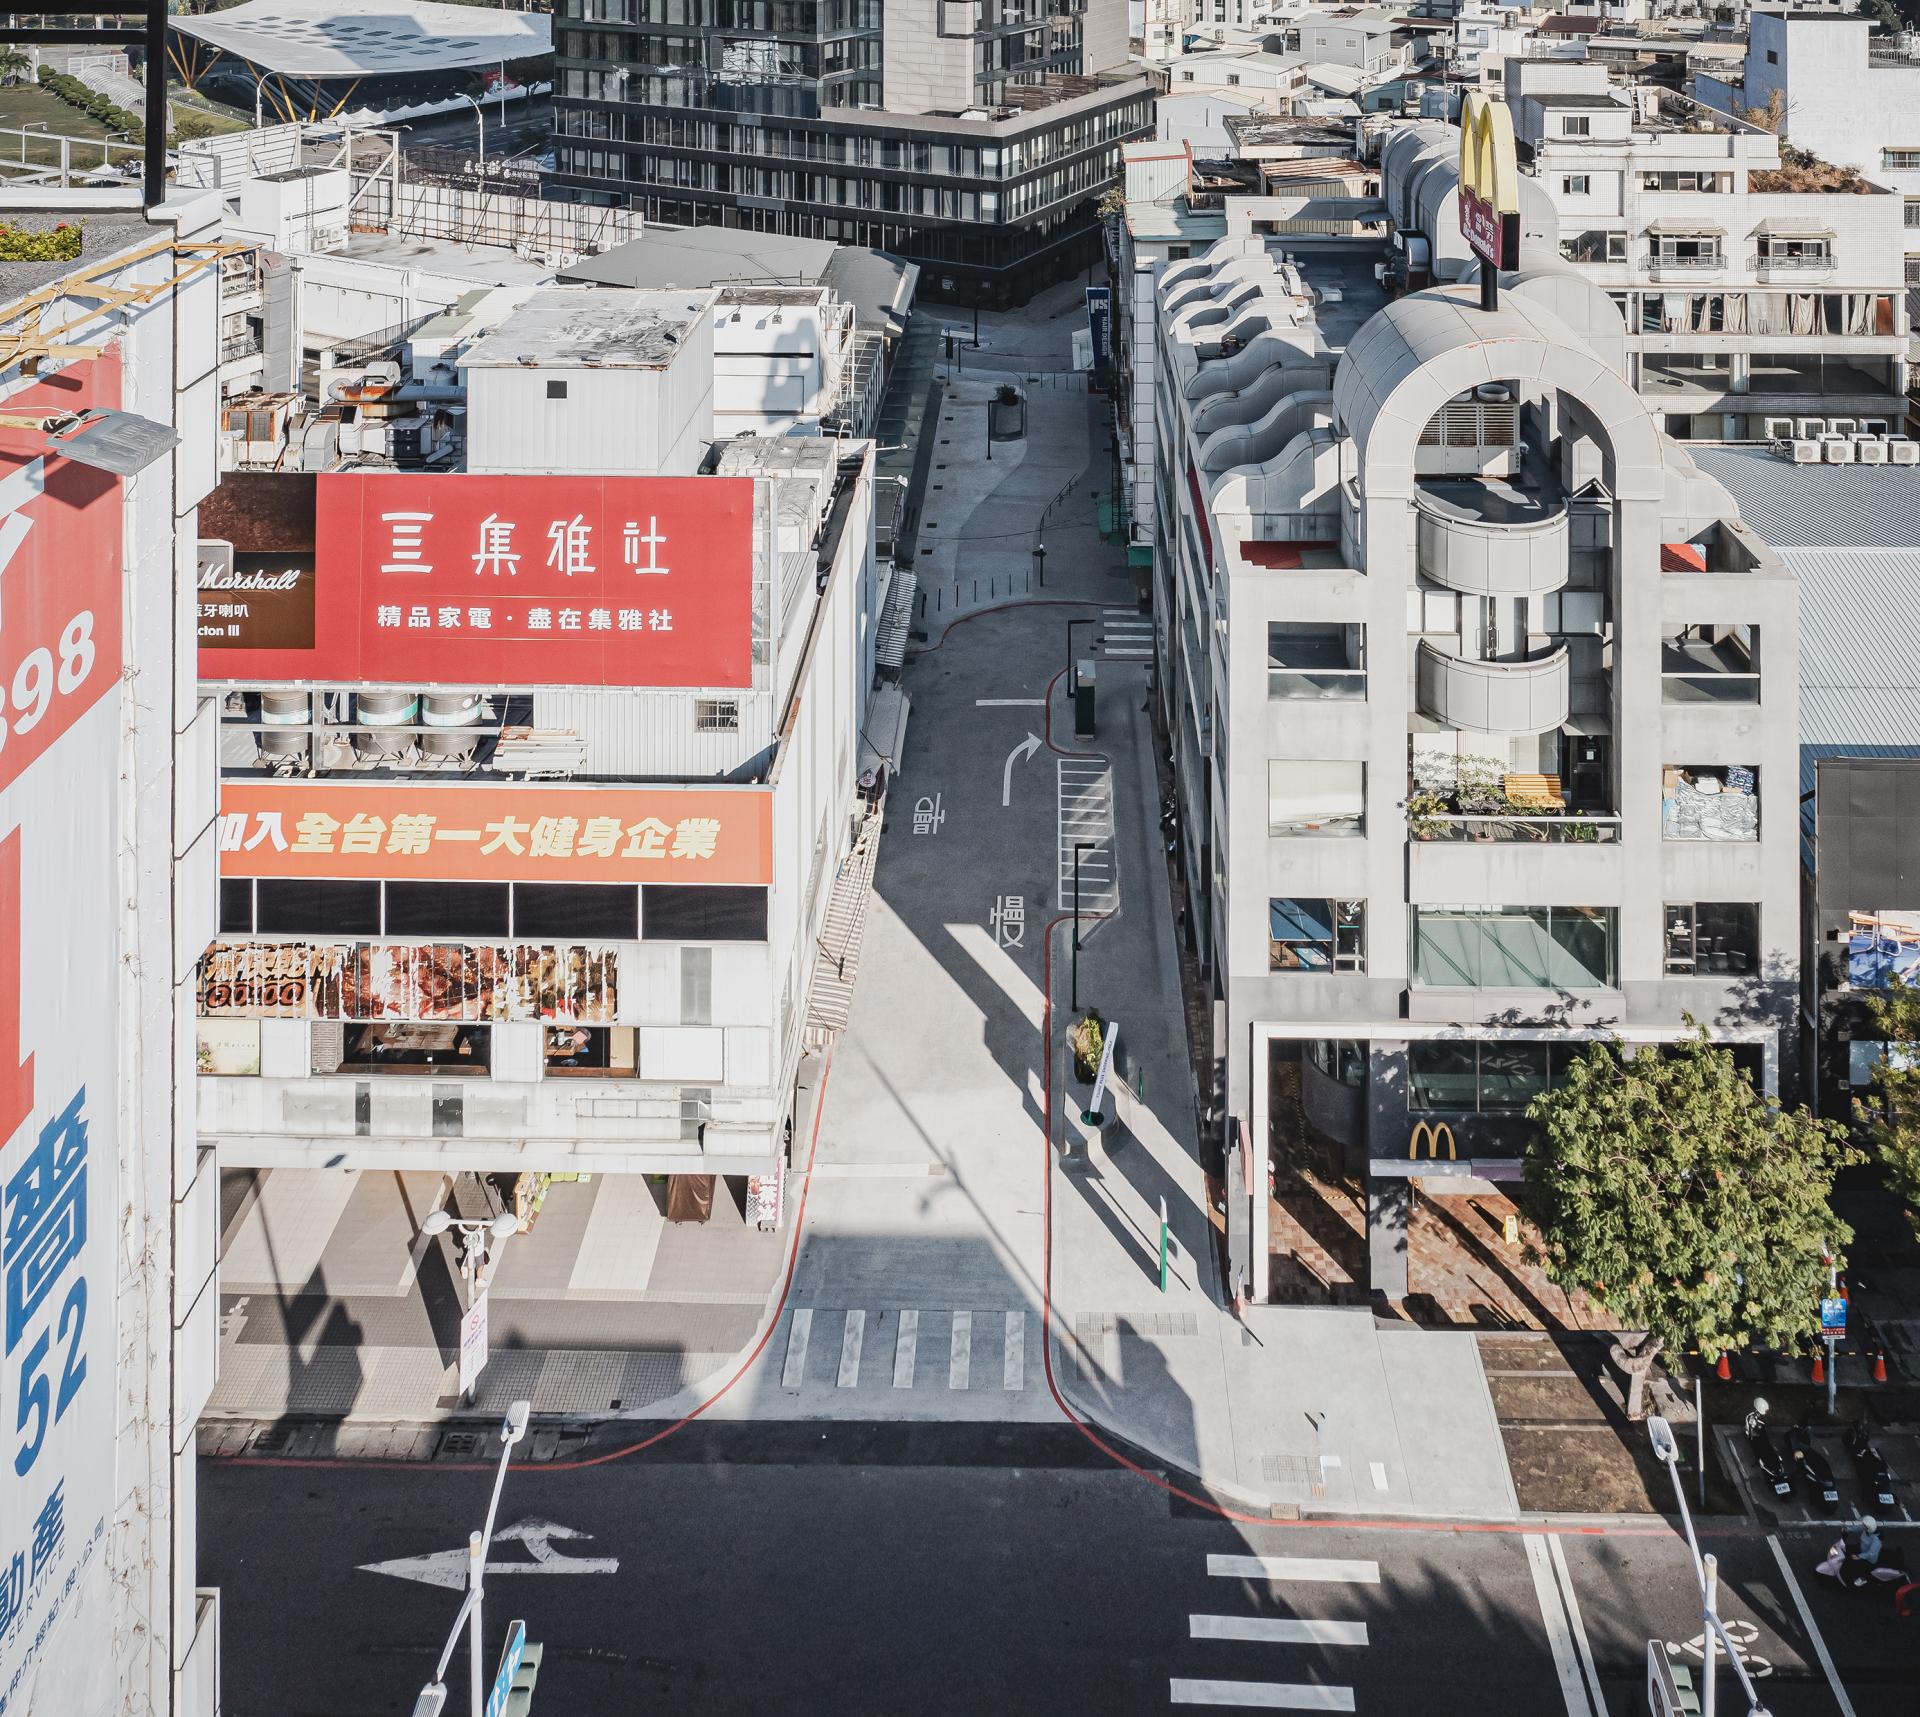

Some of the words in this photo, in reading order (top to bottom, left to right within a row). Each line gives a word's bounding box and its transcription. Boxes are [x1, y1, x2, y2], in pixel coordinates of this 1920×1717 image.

[197, 563, 300, 590] Marshall
[197, 624, 224, 637] cton
[989, 895, 1024, 948] 慢
[14, 1275, 88, 1477] 52
[8, 1537, 66, 1649] SERVICE
